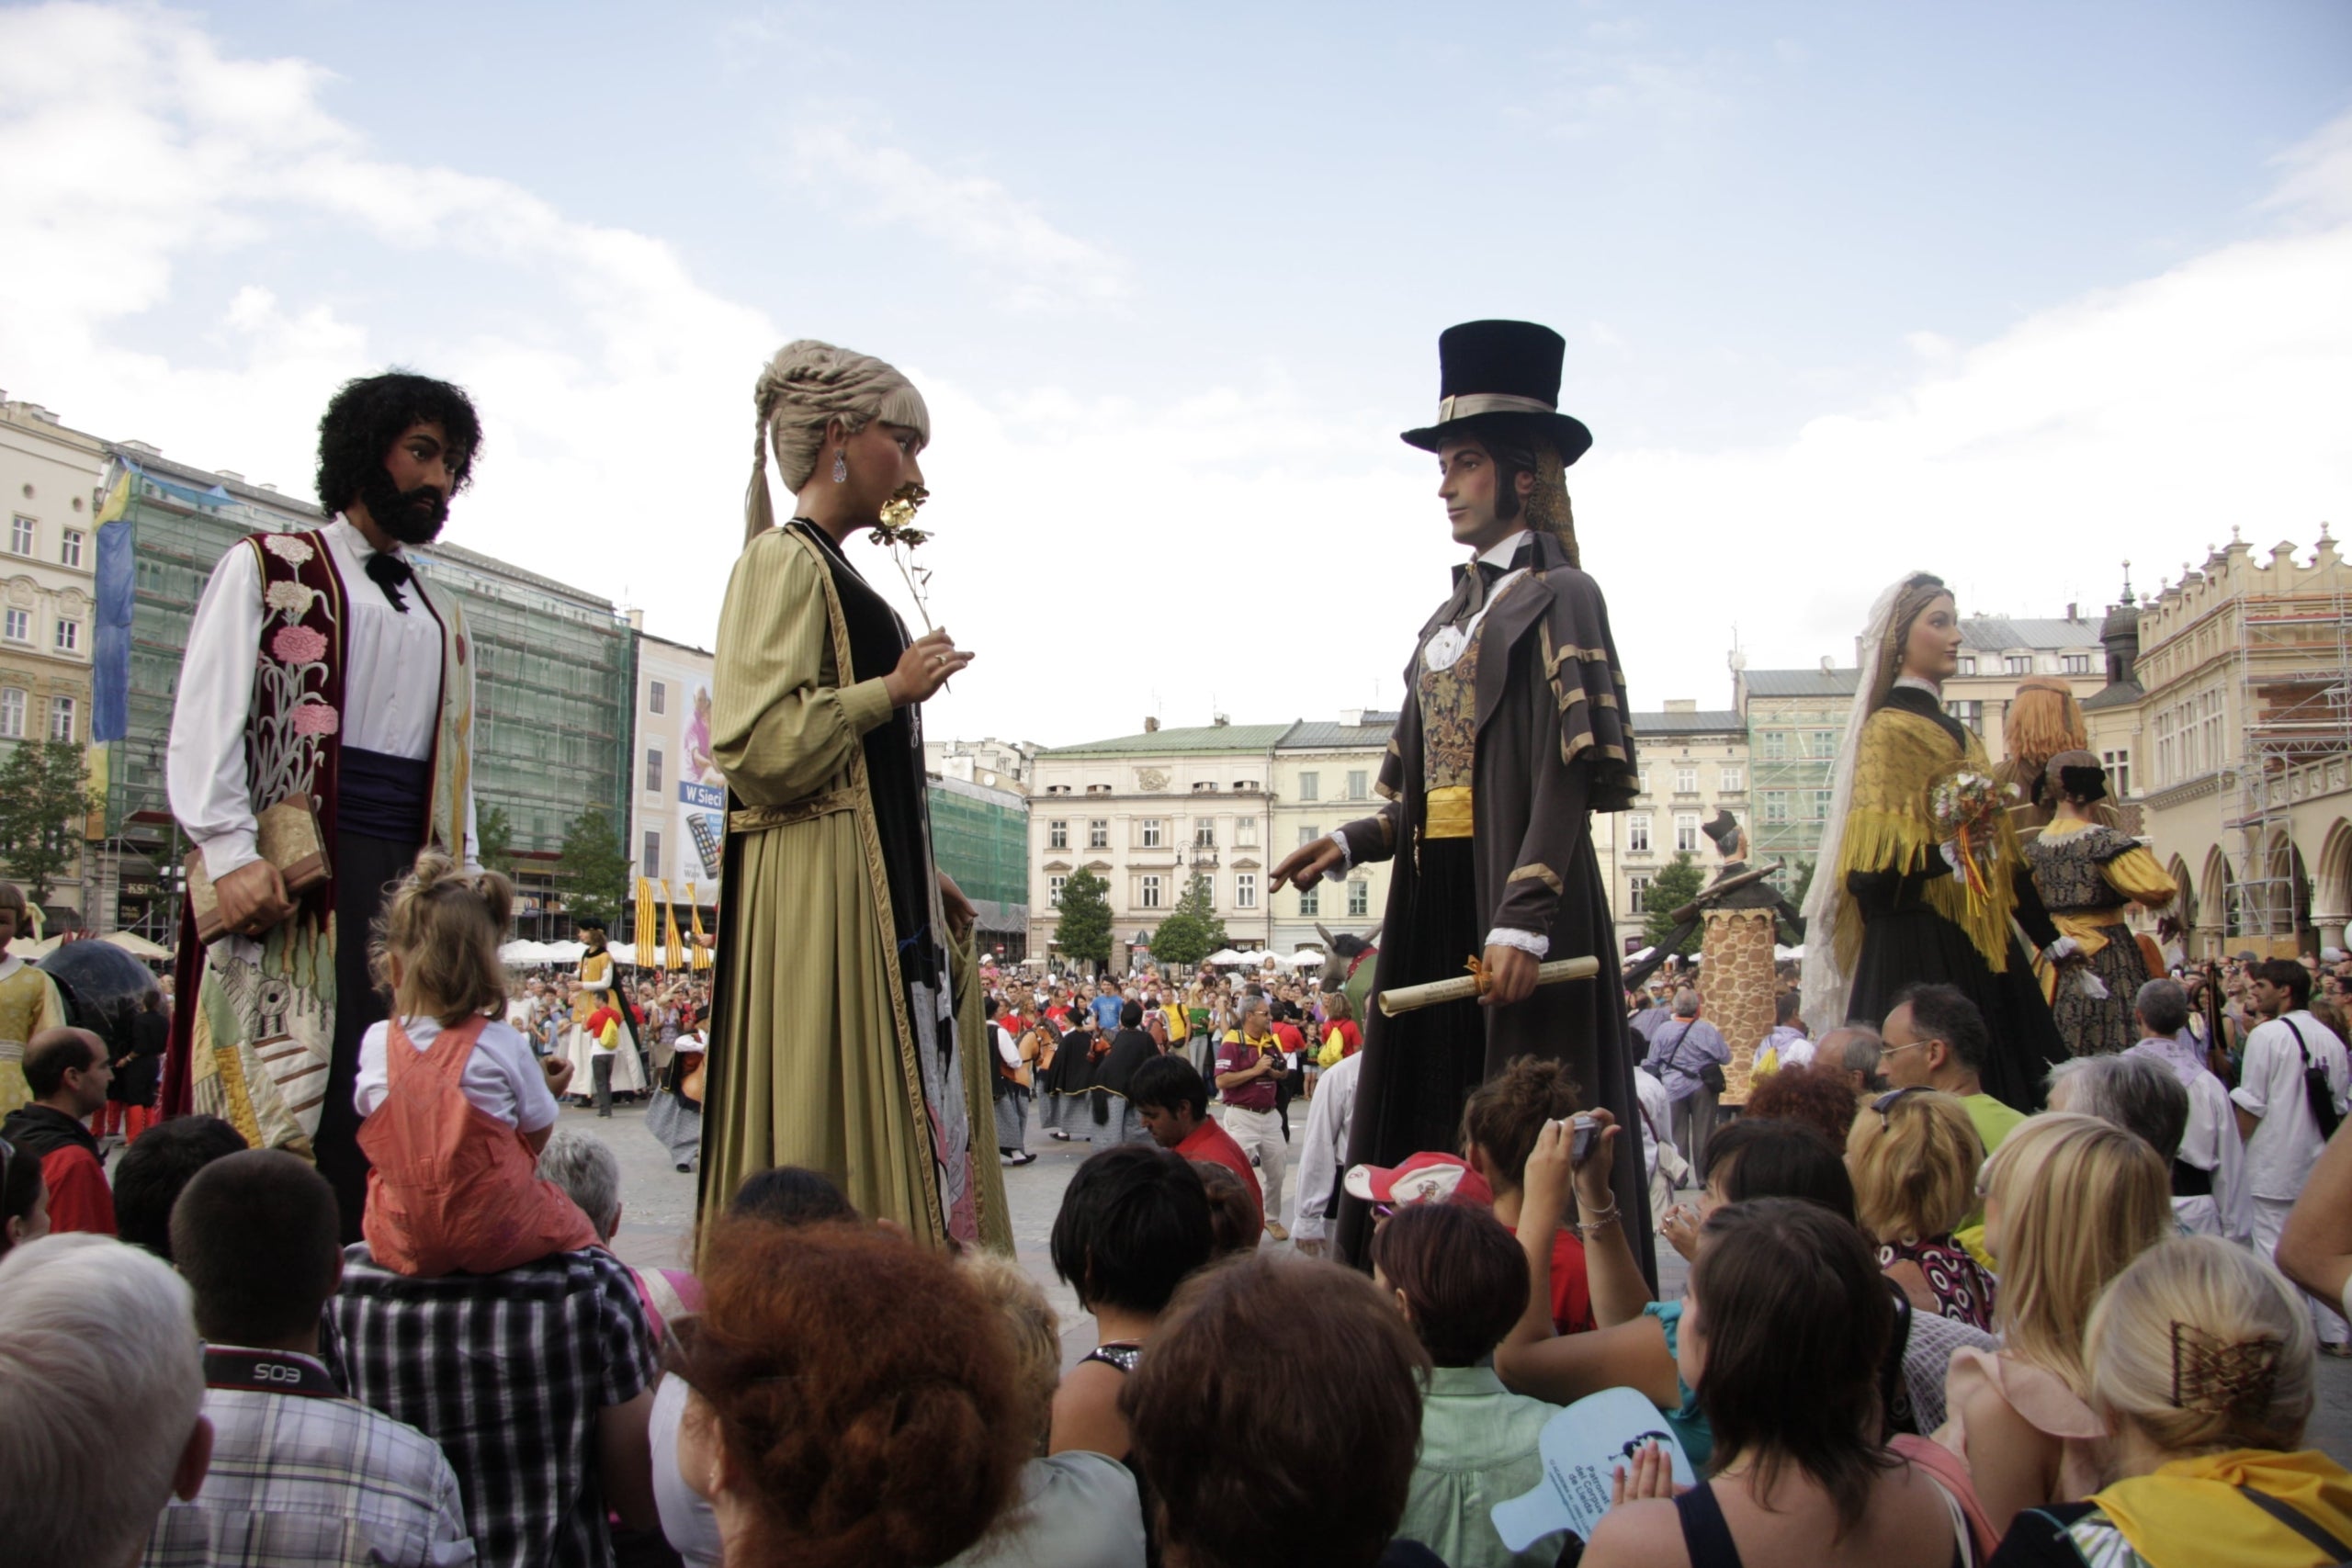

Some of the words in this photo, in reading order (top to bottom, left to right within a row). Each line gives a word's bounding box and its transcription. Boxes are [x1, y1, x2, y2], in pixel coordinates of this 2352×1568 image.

[685, 785, 696, 801] W
[698, 788, 722, 807] Sieci
[254, 1363, 301, 1383] EOS
[1568, 1473, 1578, 1485] de
[1576, 1485, 1594, 1515] Lleida
[1575, 1465, 1588, 1480] del
[1583, 1481, 1604, 1514] Corpus
[1586, 1465, 1611, 1505] Patronat
